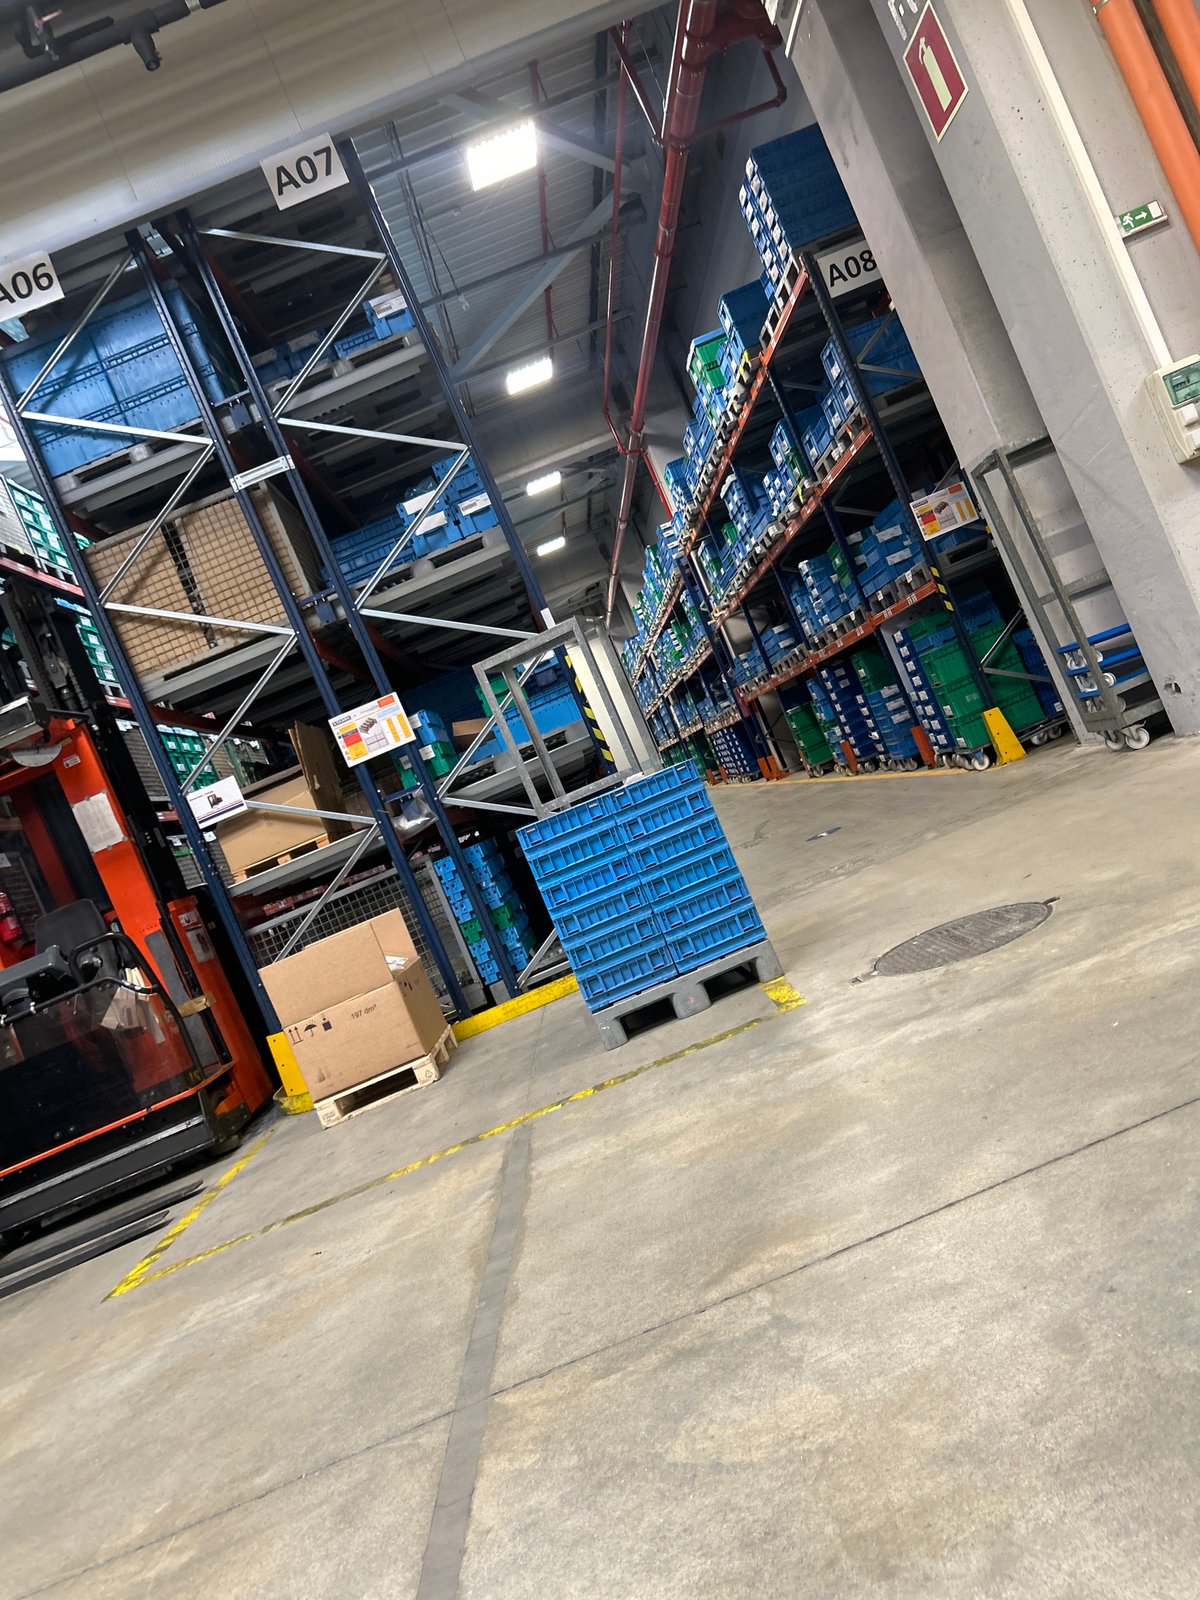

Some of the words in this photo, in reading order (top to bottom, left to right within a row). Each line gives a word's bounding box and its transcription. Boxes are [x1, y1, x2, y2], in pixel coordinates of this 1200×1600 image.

[276, 145, 332, 196] A07
[829, 249, 878, 288] A08
[351, 1009, 362, 1020] 197
